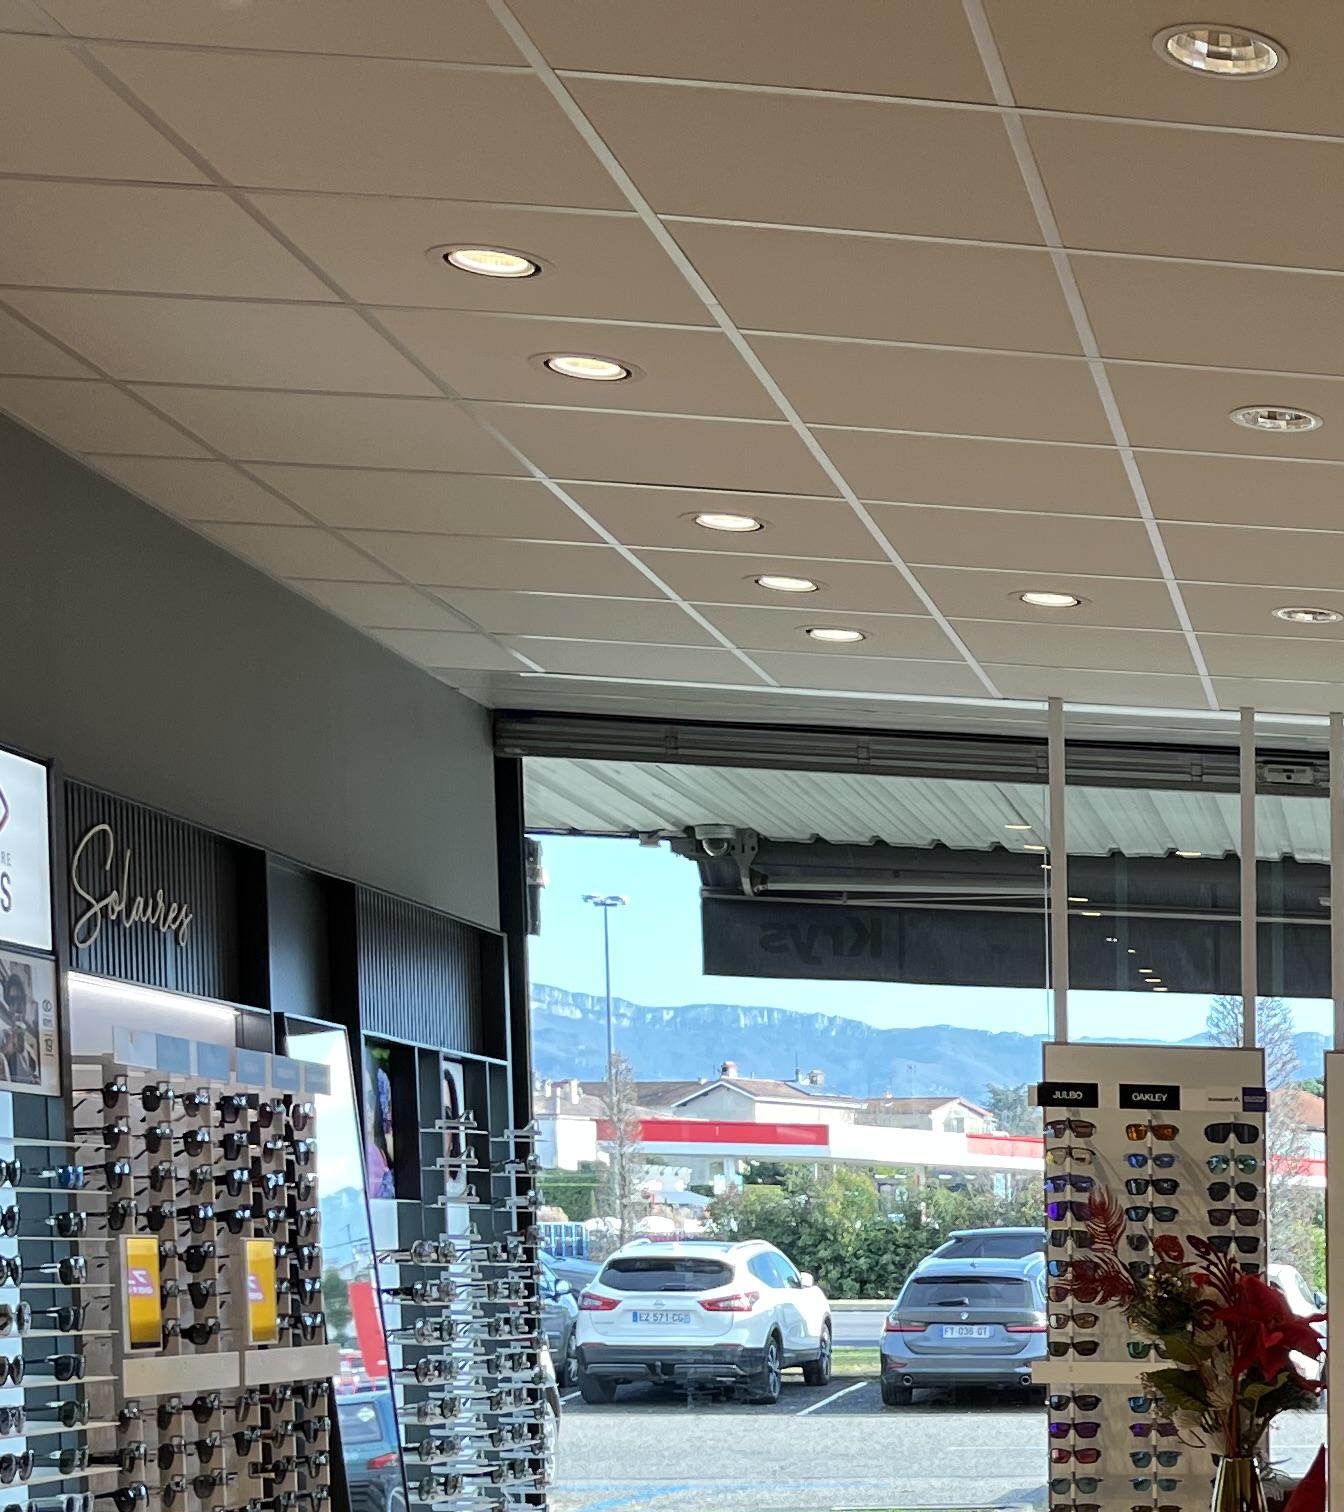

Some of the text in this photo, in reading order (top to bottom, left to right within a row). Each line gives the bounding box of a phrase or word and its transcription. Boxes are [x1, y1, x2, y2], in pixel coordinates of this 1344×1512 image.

[72, 824, 192, 948] Solaires
[1052, 1091, 1083, 1099] JULBO
[1132, 1092, 1168, 1102] OAKLEY
